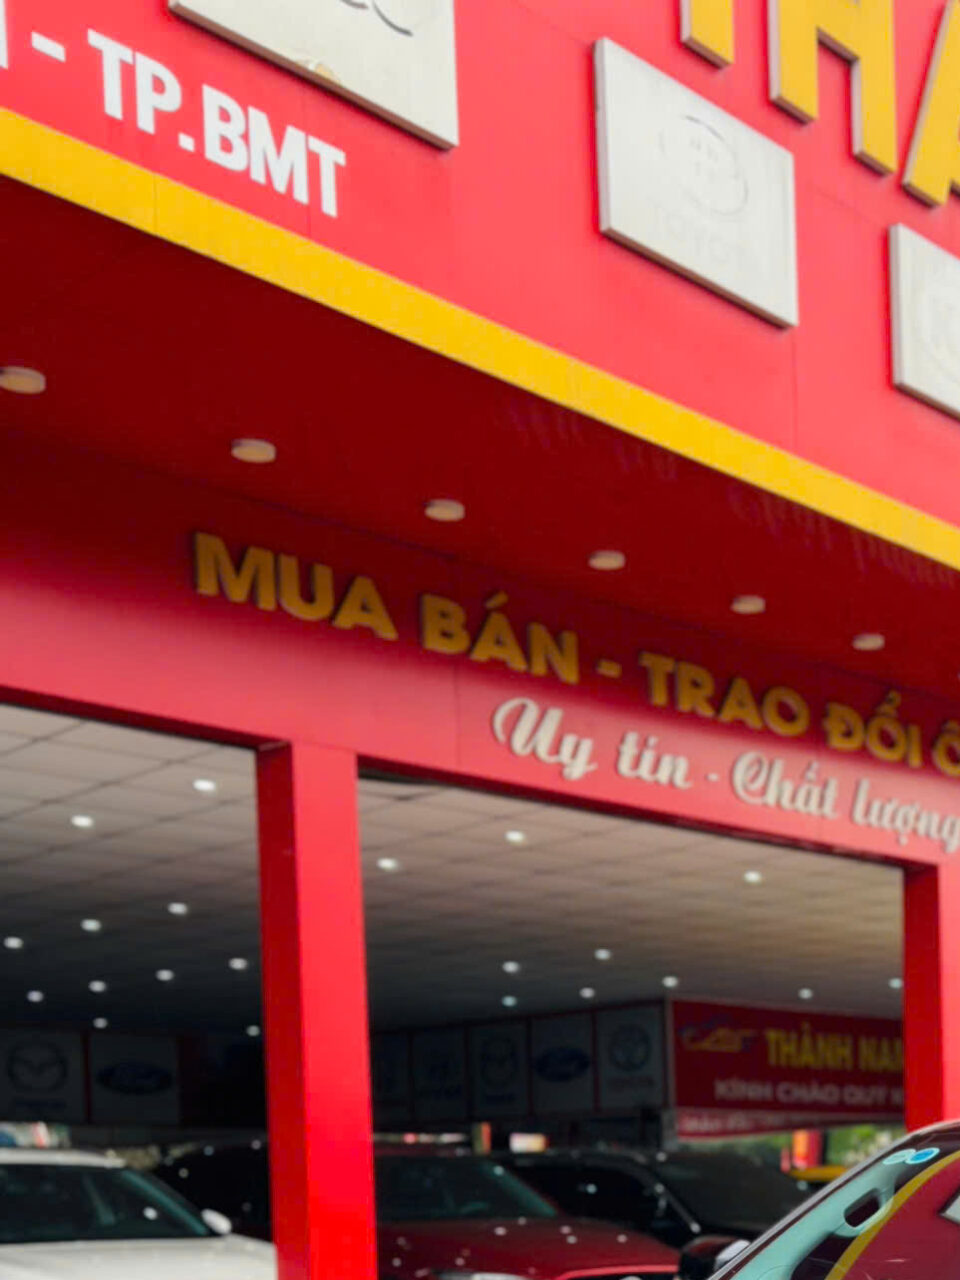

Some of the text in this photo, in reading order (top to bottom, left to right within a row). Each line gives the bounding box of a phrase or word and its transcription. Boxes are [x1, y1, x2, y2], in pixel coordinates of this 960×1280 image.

[87, 28, 346, 217] TP.BMT
[194, 531, 398, 641] MUA
[420, 591, 580, 684] BÁN
[639, 652, 810, 737] TRAO
[823, 690, 922, 769] ĐỔI
[492, 697, 597, 780] Uy
[616, 731, 691, 789] tín
[732, 752, 839, 819] Chất
[763, 1021, 904, 1072] THÀNH NA
